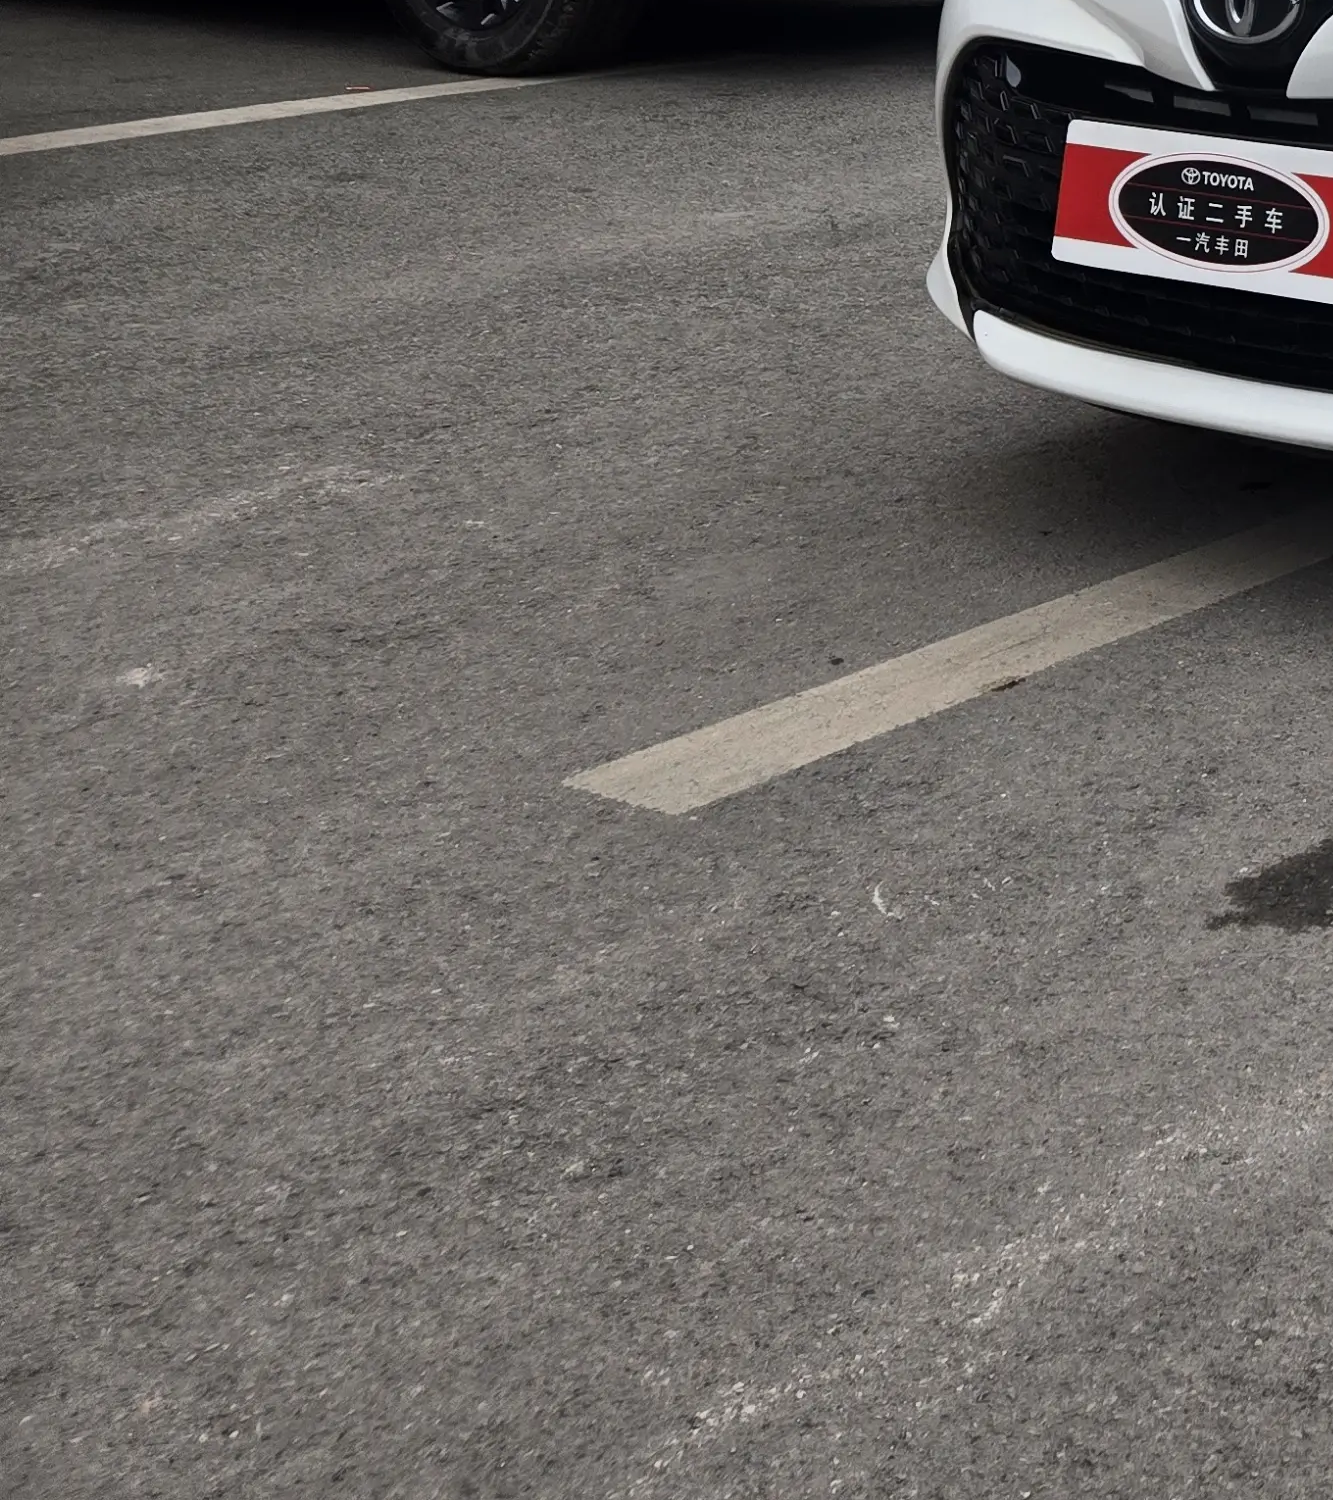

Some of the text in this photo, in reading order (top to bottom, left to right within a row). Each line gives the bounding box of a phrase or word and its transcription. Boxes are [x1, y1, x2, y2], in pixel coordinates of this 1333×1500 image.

[1202, 171, 1255, 192] TOYOTA
[1148, 192, 1284, 235] 认证二手车
[1175, 231, 1249, 259] 一汽丰田
